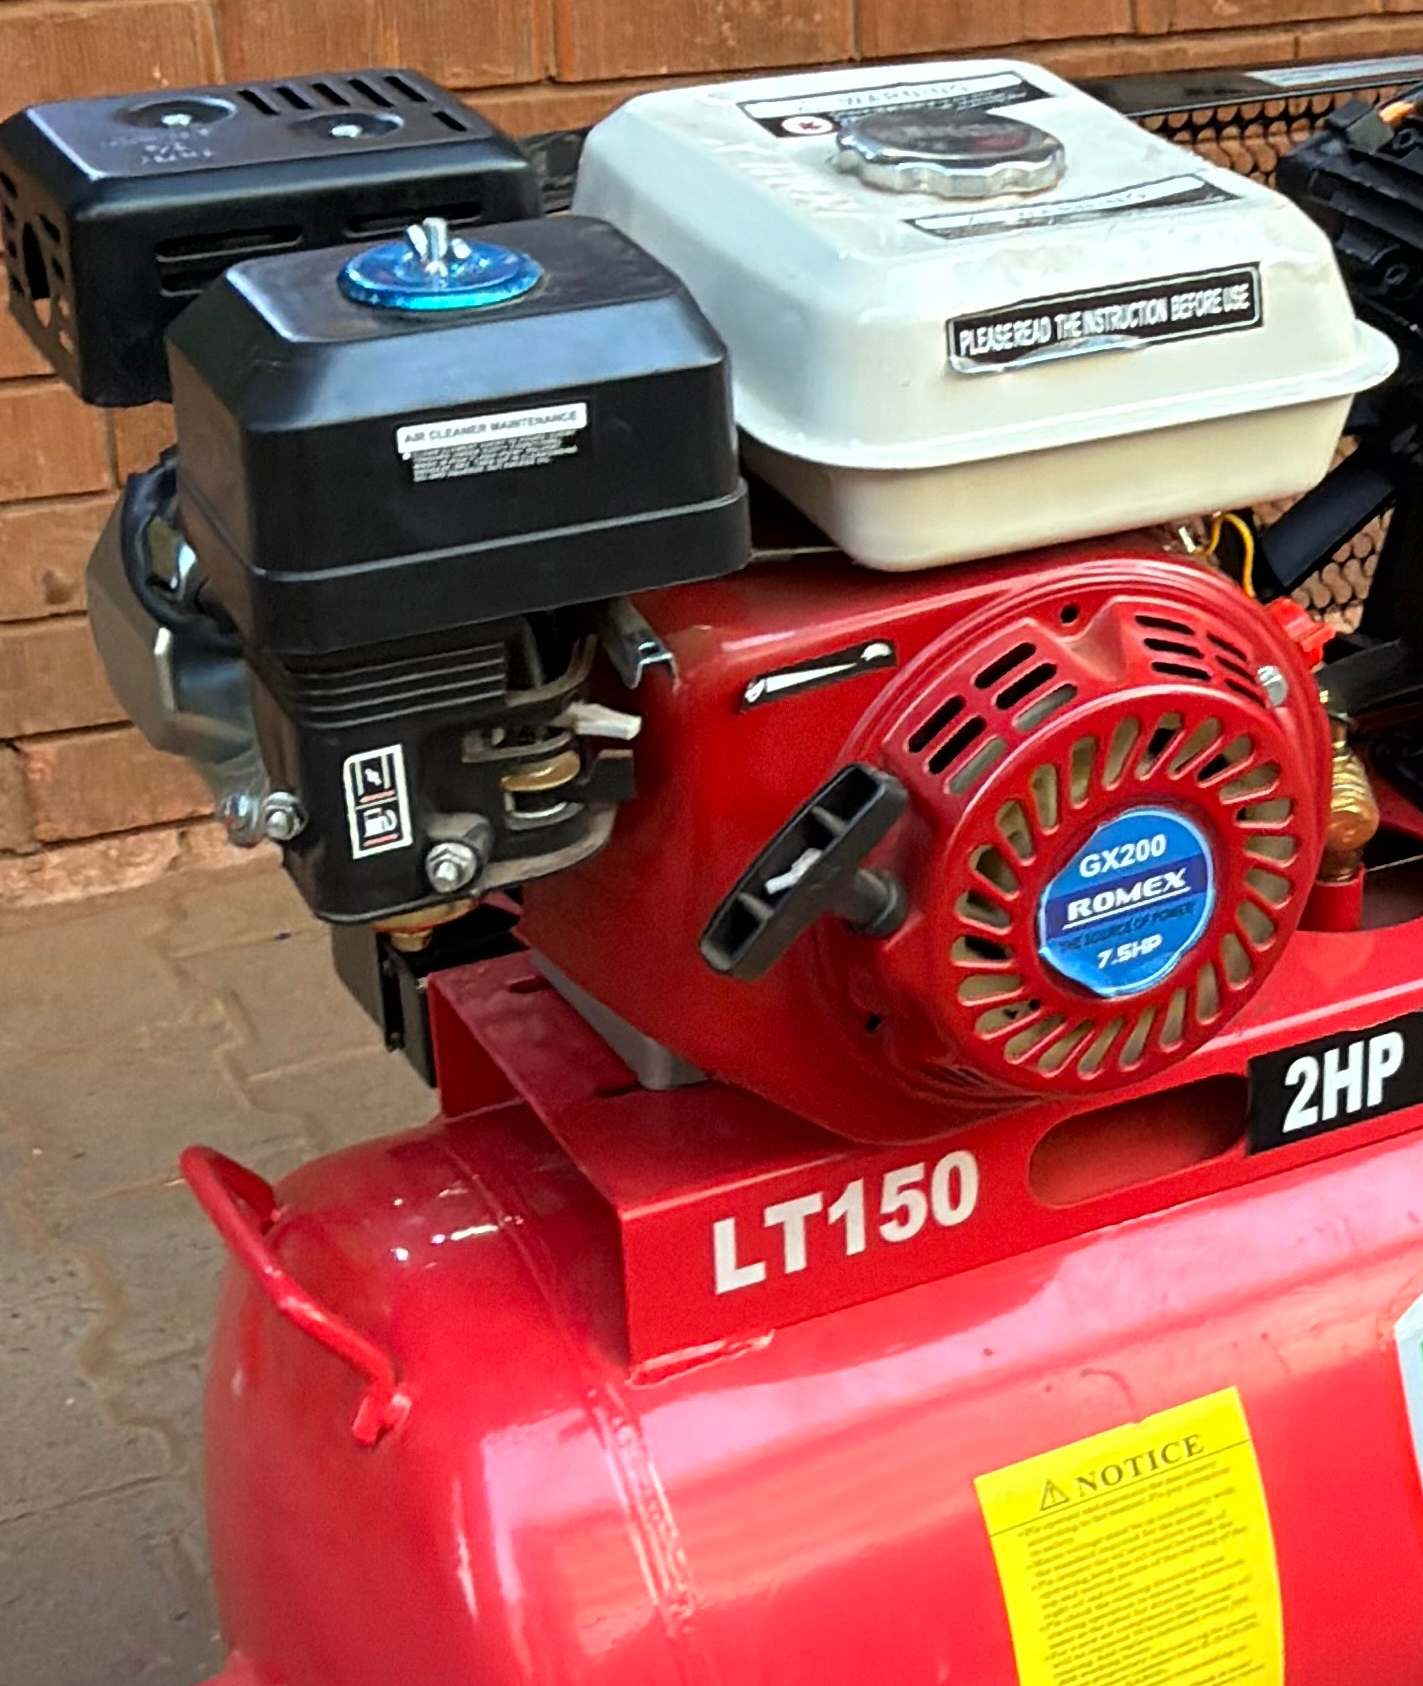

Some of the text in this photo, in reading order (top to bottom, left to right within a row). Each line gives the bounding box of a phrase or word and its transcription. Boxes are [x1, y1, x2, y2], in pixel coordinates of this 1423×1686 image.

[959, 283, 1250, 357] PLEASE READ THE INSTRUCTION BEFORE USE
[404, 410, 577, 444] AIR CLEANER MAINTENANCE
[1079, 833, 1167, 878] GX200
[1067, 867, 1187, 922] ROMEX
[1097, 933, 1164, 970] 7.5HP
[1281, 1030, 1405, 1134] 2HP
[711, 1150, 980, 1297] LT150
[1074, 1432, 1206, 1498] NOTICE
